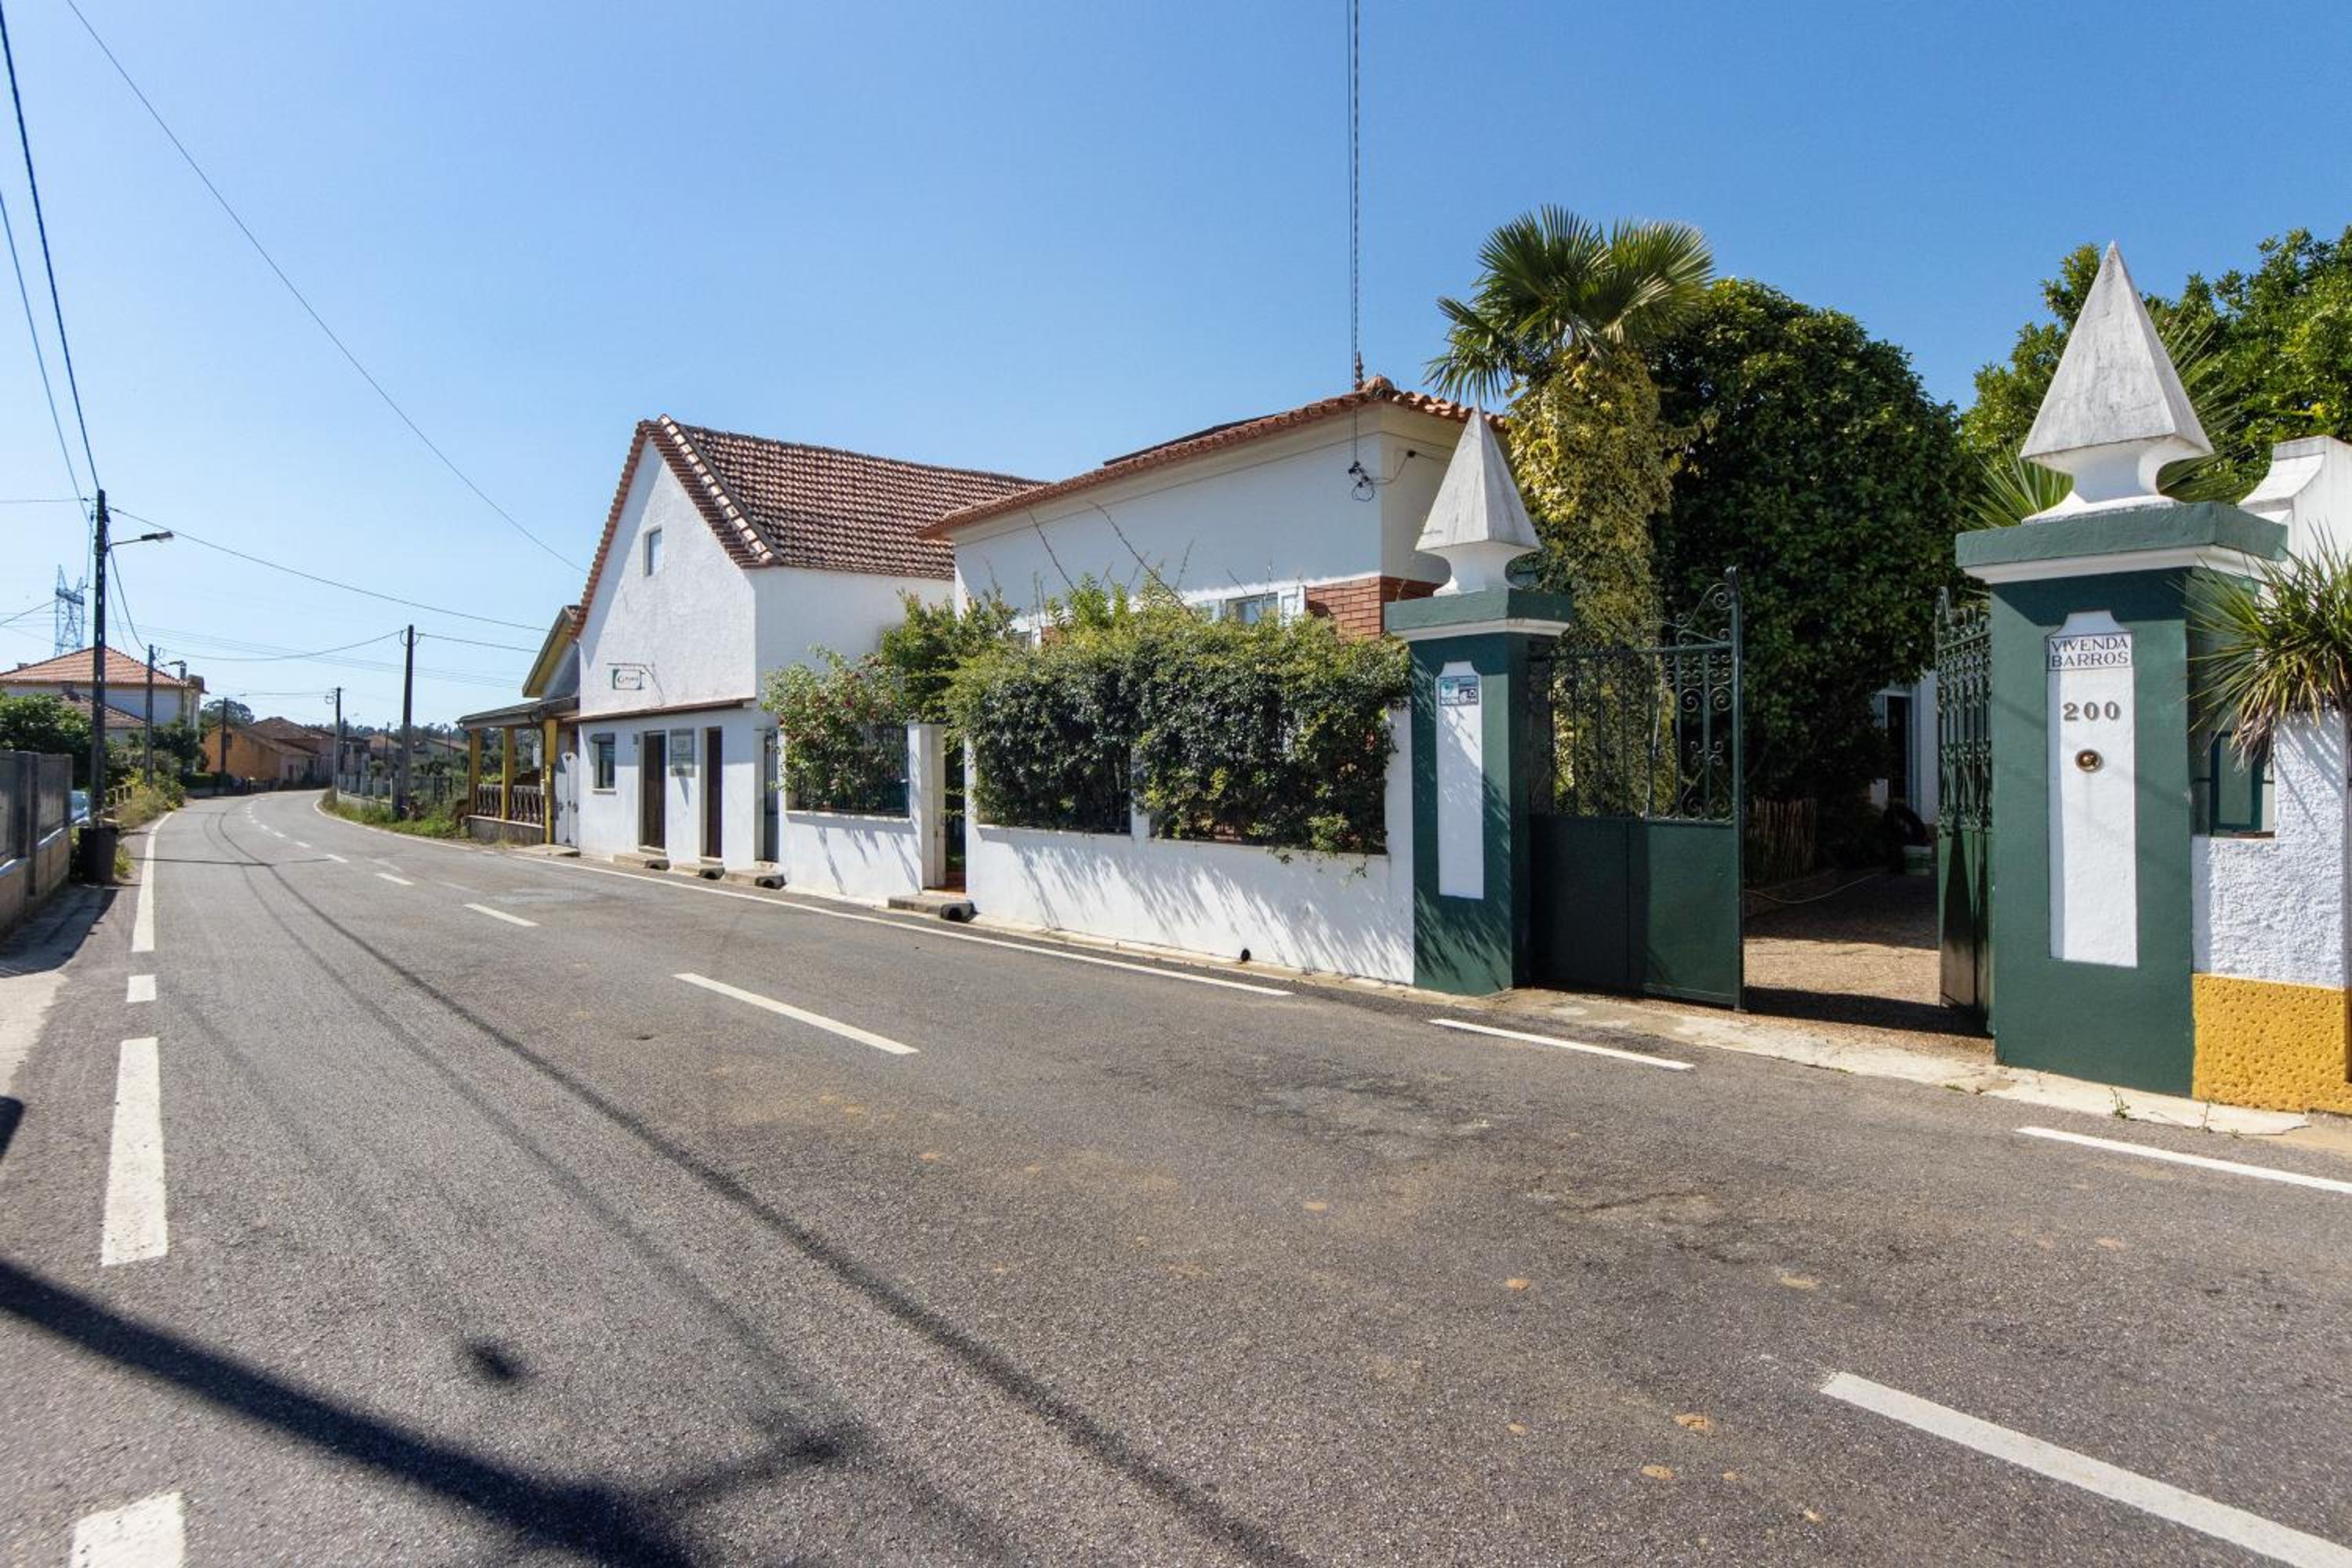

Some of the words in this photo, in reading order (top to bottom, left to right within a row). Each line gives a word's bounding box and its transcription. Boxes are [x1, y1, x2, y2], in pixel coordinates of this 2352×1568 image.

[2051, 637, 2129, 652] VIVENDA
[2051, 652, 2129, 667] BARROS
[2063, 701, 2121, 720] 200
